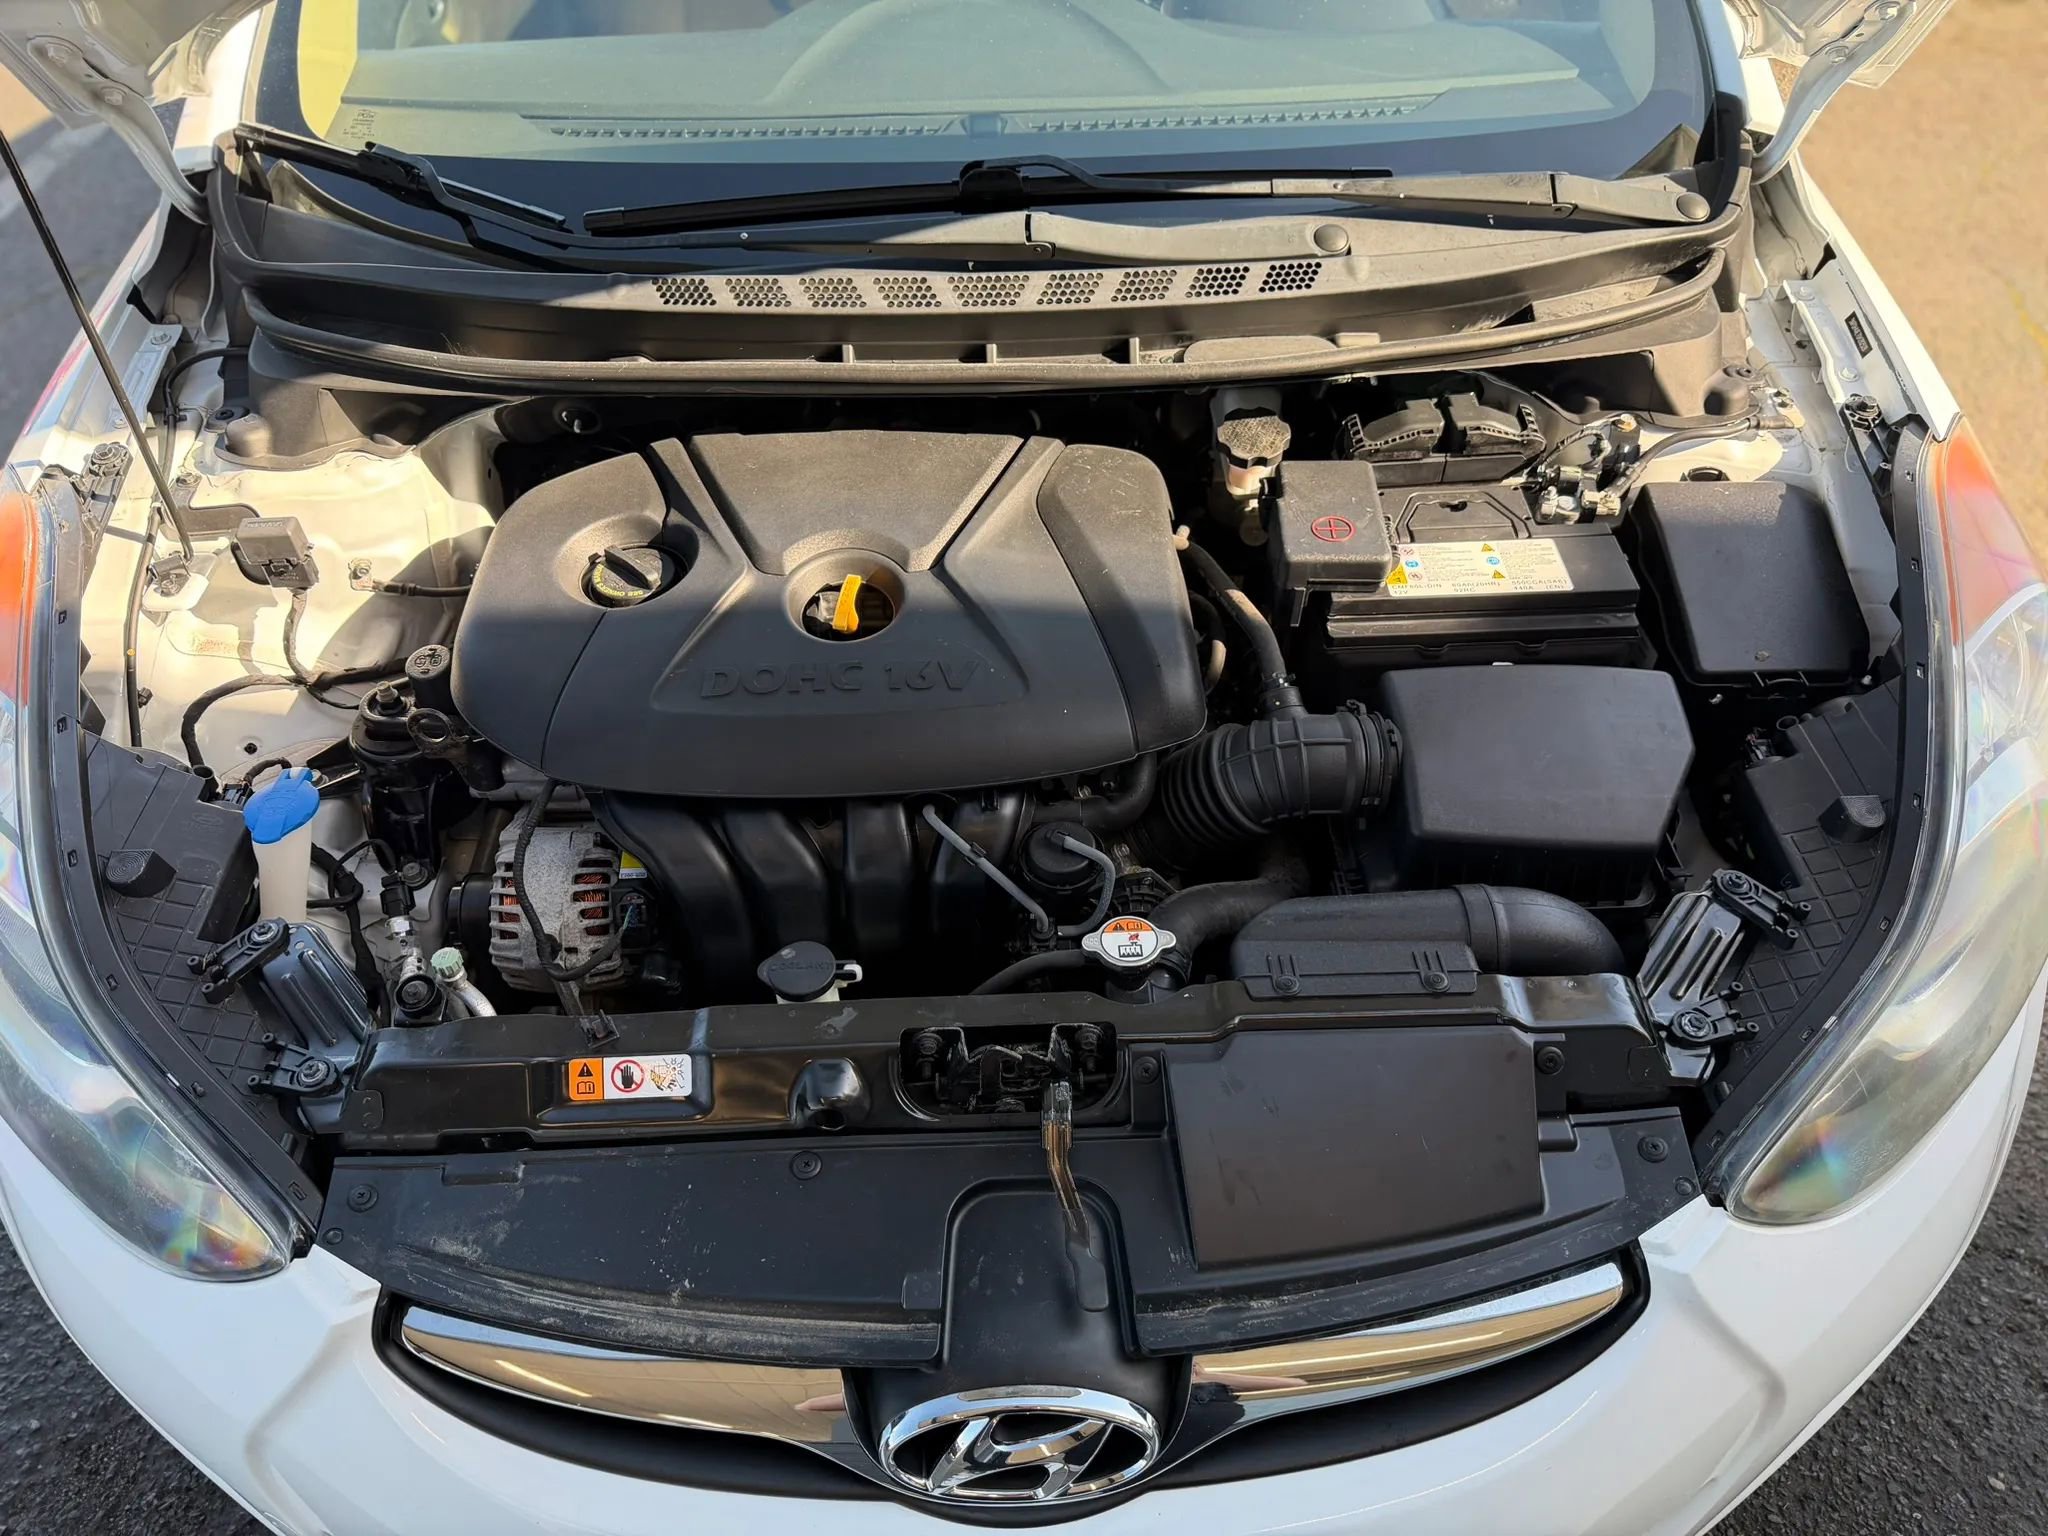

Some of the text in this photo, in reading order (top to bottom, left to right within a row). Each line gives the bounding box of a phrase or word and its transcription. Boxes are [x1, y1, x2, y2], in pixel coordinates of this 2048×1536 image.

[701, 660, 980, 699] DOHC 16V
[768, 960, 832, 972] COOLANT
